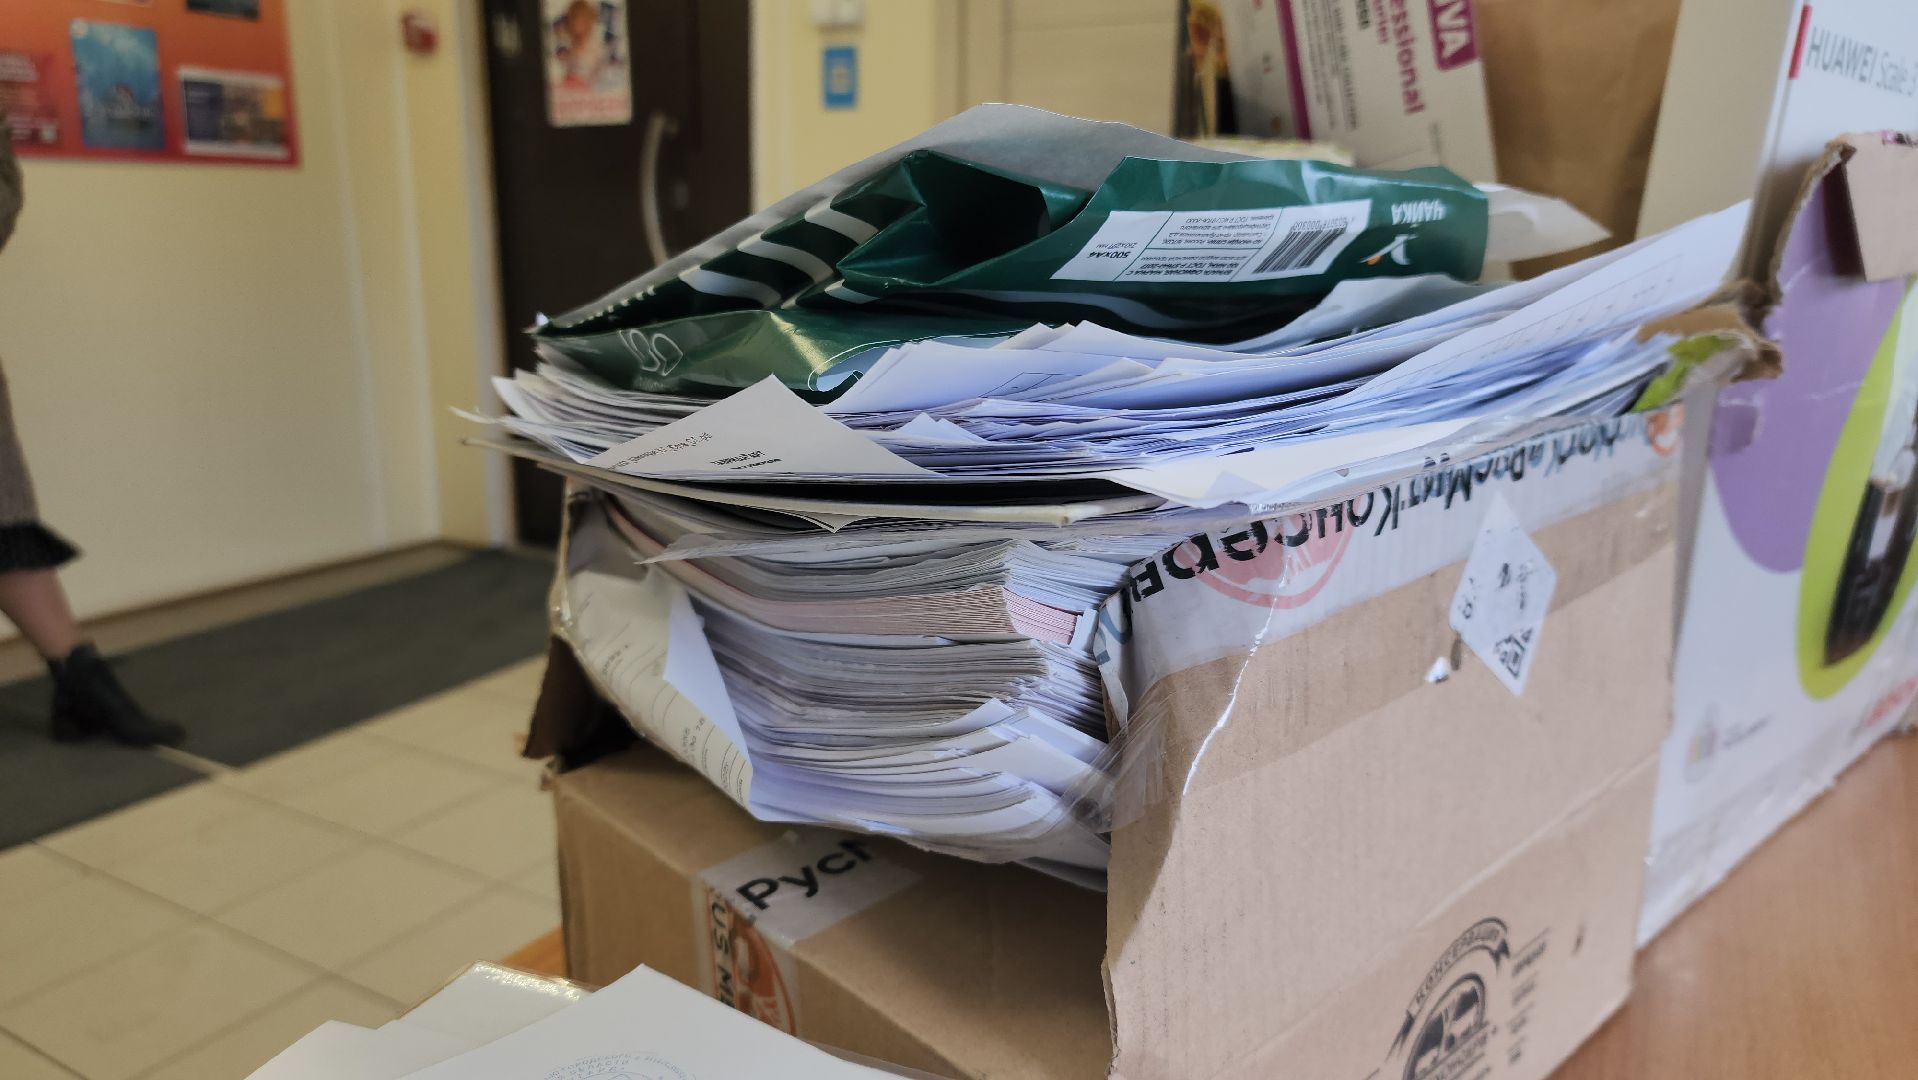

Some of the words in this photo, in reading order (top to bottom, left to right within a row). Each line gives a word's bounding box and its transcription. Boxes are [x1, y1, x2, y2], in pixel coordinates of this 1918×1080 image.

[1433, 0, 1470, 59] VA
[1806, 26, 1878, 83] HUAWEI
[1876, 51, 1908, 94] Scale
